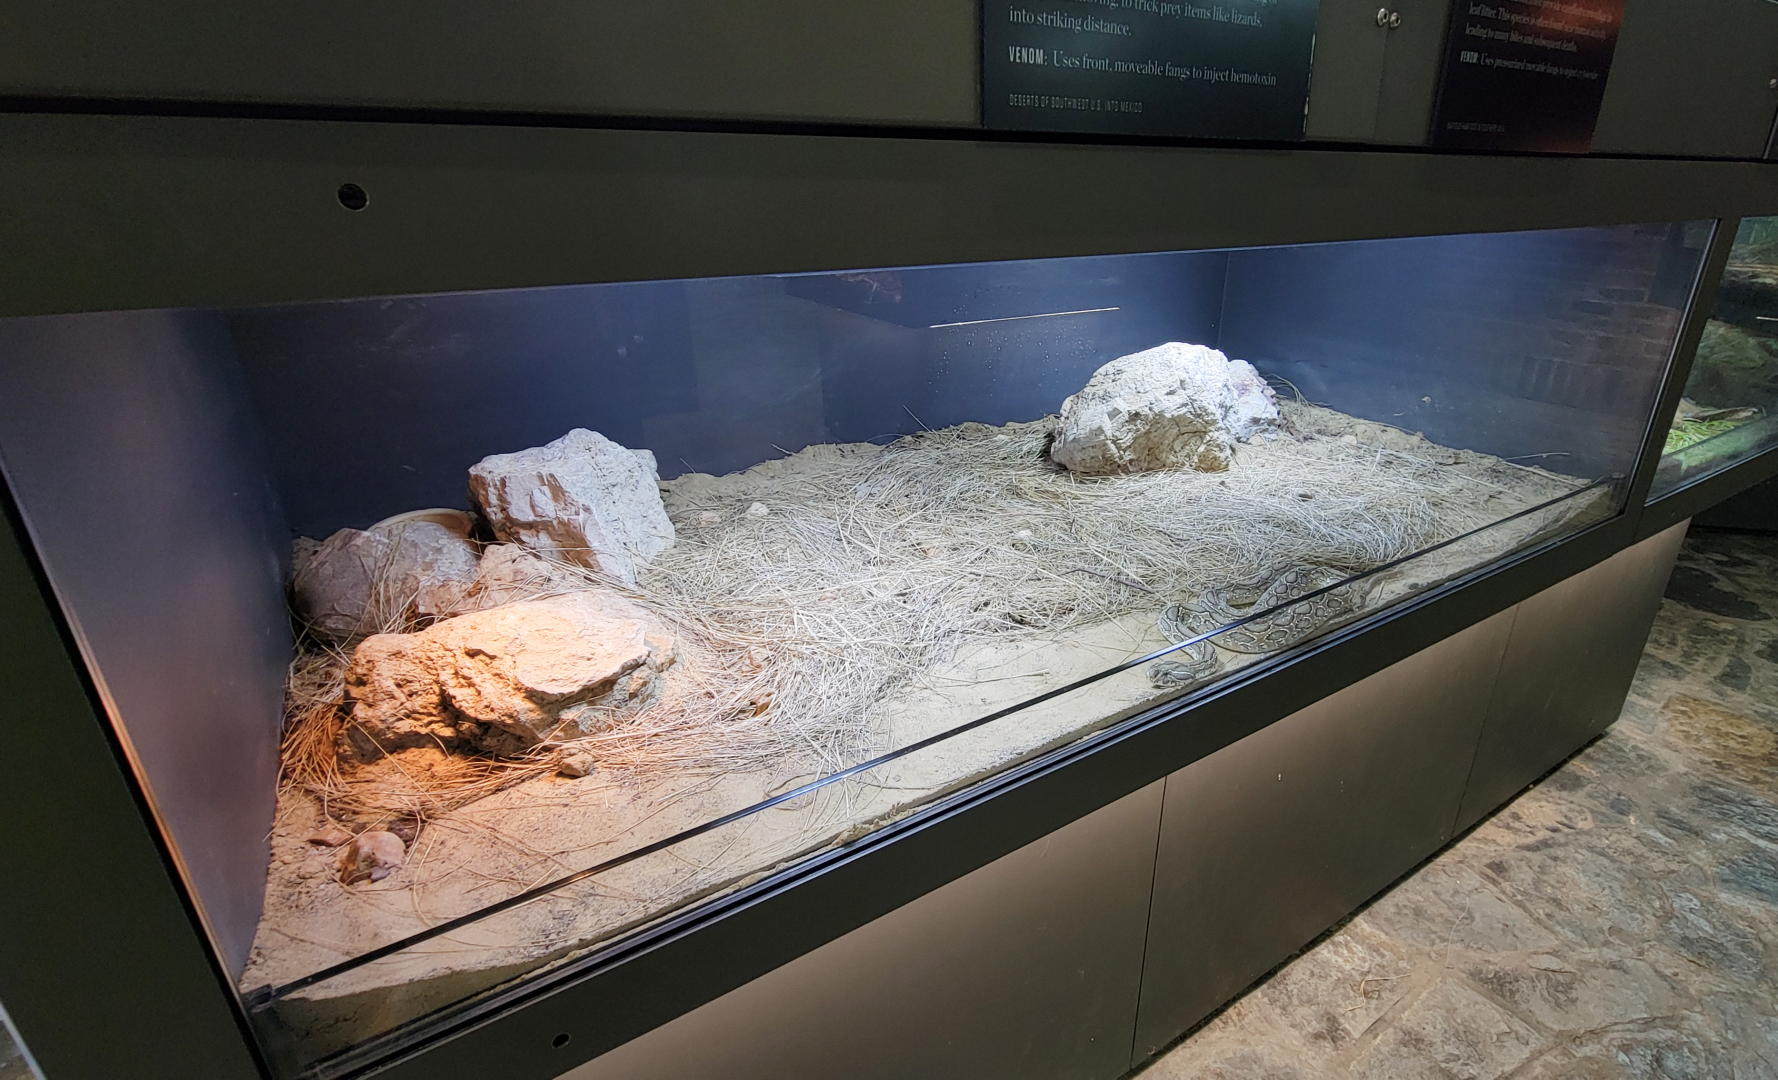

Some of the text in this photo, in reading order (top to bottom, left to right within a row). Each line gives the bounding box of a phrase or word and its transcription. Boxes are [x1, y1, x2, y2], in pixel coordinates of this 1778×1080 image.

[1009, 6, 1132, 36] into striking distance.
[1134, 0, 1159, 12] trick
[1160, 2, 1183, 19] prey
[1184, 2, 1211, 19] items
[1212, 5, 1230, 22] like
[1008, 45, 1048, 66] VENOM:
[1052, 50, 1080, 68] Uses
[1114, 59, 1163, 76] moveable
[1165, 61, 1191, 82] fangs
[1192, 66, 1203, 79] to
[1203, 66, 1229, 84] inject
[1231, 68, 1277, 87] hemotoxin
[1009, 93, 1039, 107] DESERTS
[1040, 95, 1050, 108] OF
[1051, 96, 1090, 110] SOUTHWEST
[1120, 101, 1143, 113] MEXICO
